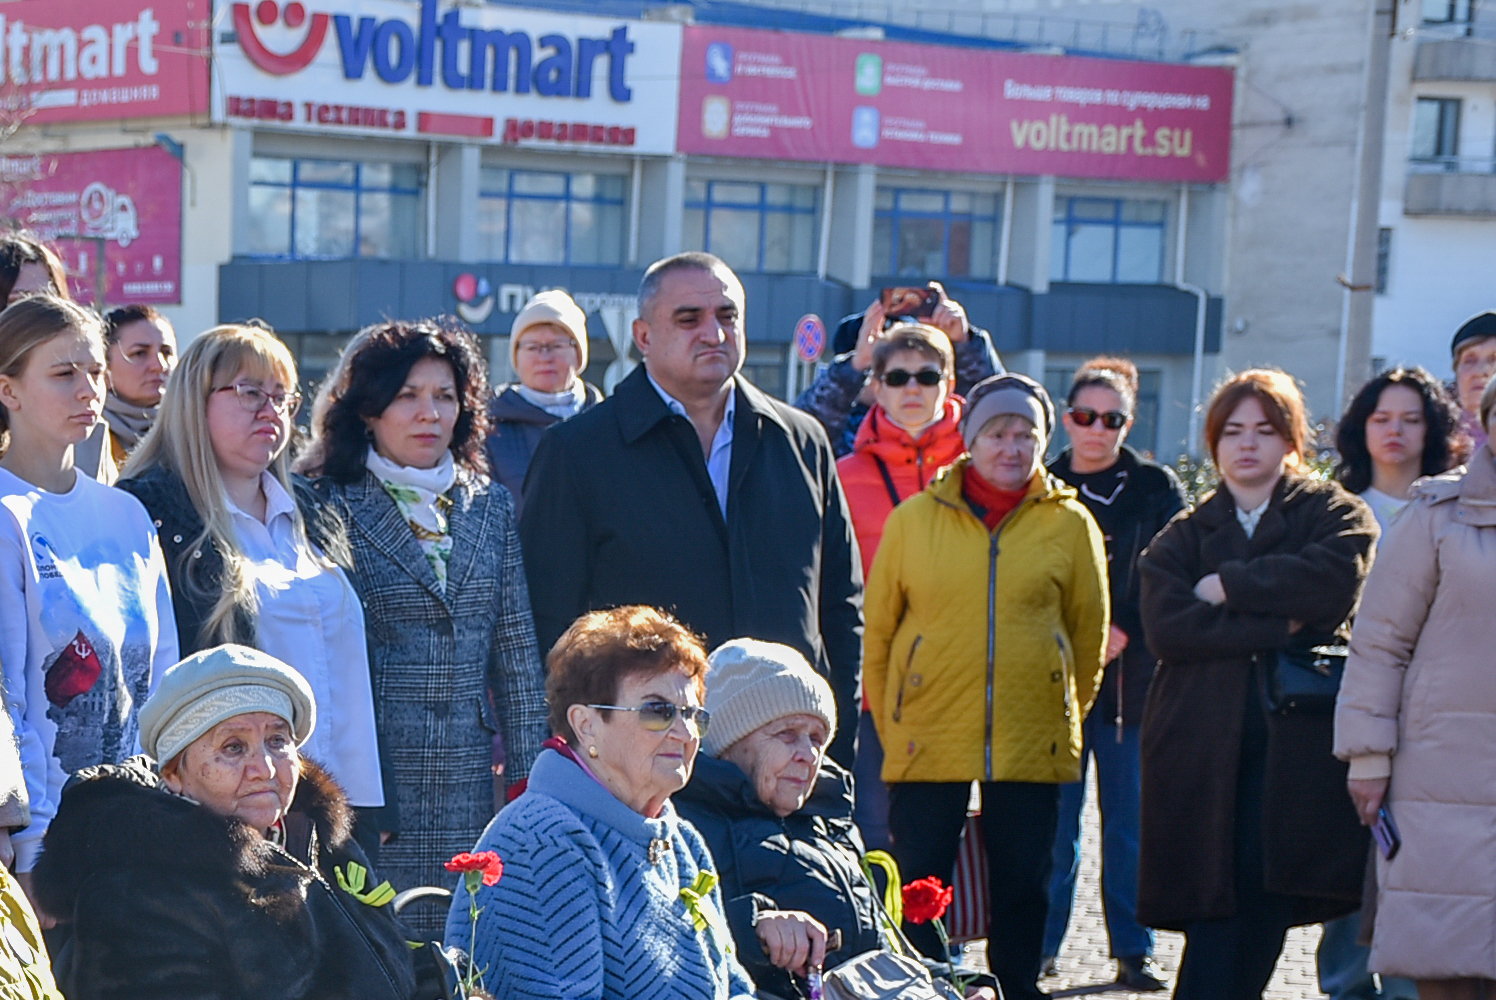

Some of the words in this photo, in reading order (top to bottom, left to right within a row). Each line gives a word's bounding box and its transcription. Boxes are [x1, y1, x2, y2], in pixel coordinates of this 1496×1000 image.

[333, 0, 634, 102] voltmart
[226, 95, 294, 122] наша
[305, 101, 406, 130] техника
[504, 117, 636, 147] домашняя
[1010, 113, 1194, 157] voltmart.su
